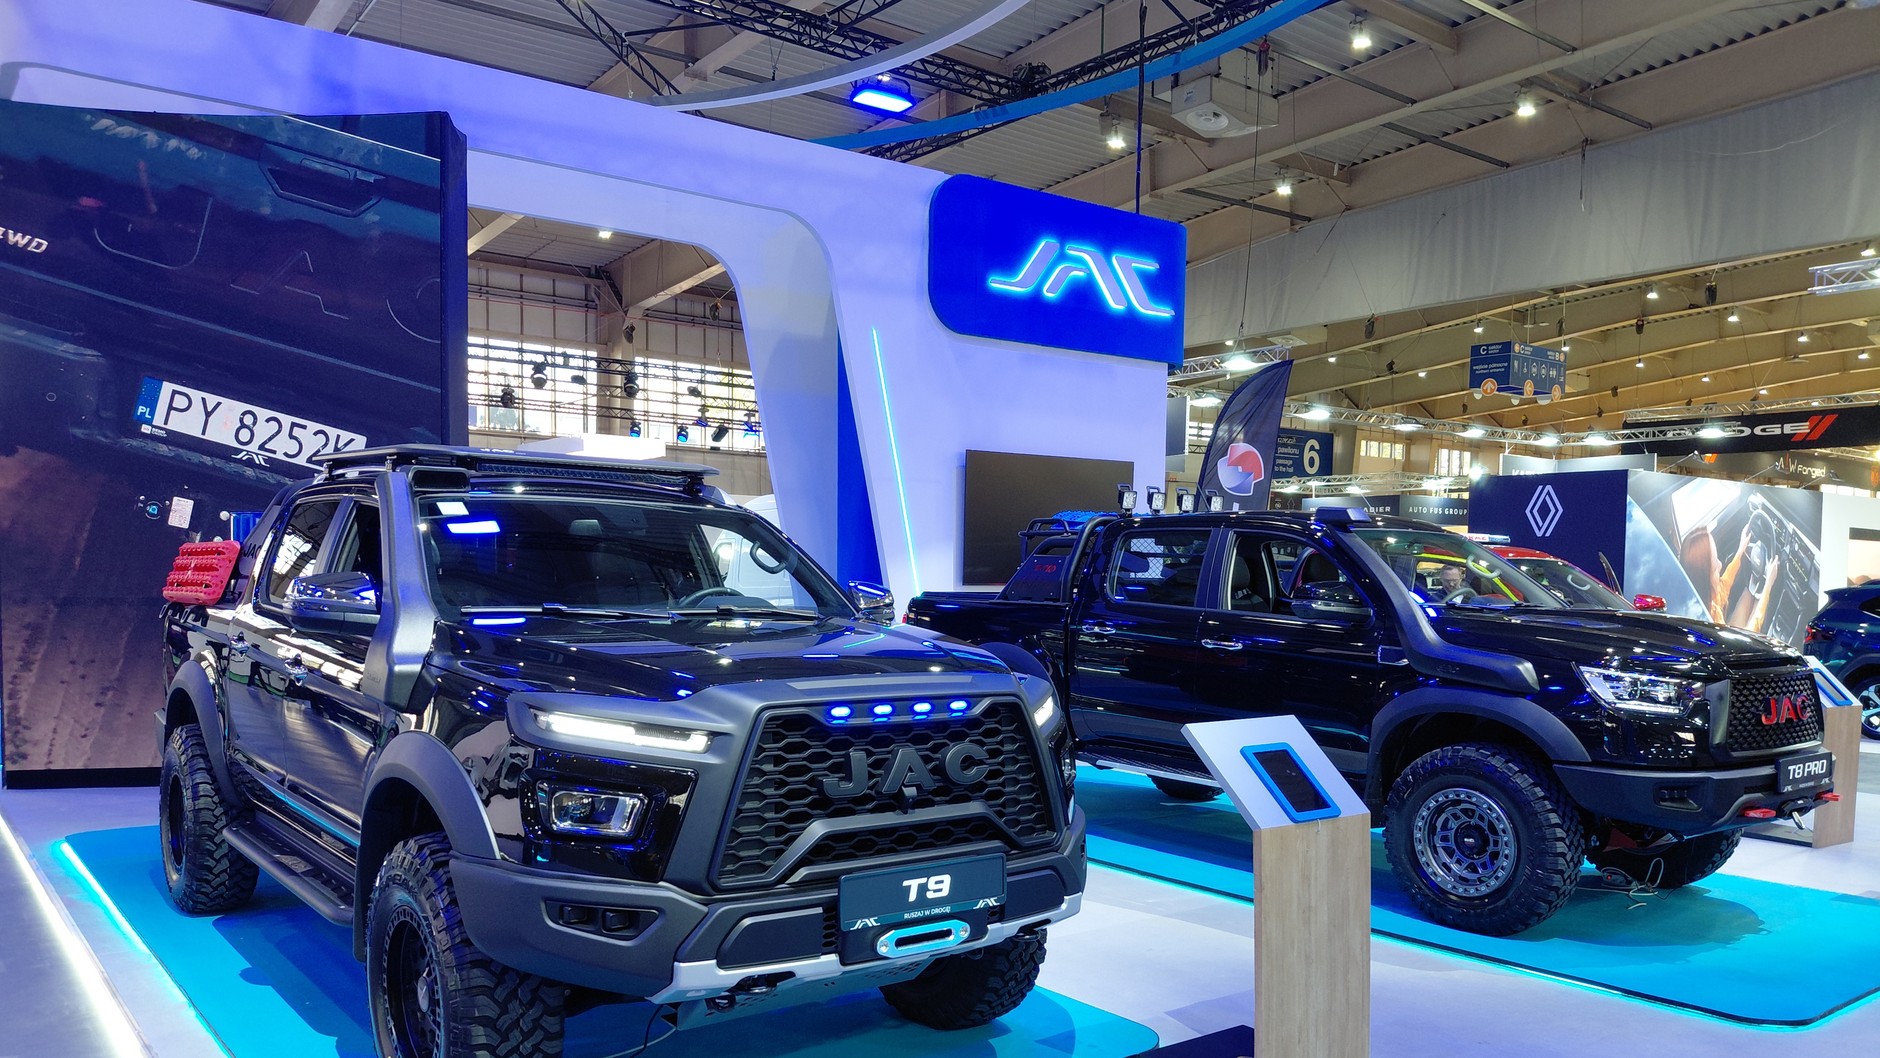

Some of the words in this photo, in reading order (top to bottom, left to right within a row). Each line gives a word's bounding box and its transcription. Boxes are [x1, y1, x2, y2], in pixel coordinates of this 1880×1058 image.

[989, 240, 1176, 316] JAC
[1480, 346, 1487, 354] C
[137, 405, 152, 419] PL
[164, 388, 222, 436] PY
[231, 450, 270, 467] JAC
[1303, 438, 1320, 475] 6
[1797, 464, 1826, 479] Forged
[1409, 506, 1428, 514] AUTO
[1429, 507, 1443, 515] FUS
[1444, 508, 1468, 516] GROUP
[1761, 694, 1811, 725] JAC
[822, 742, 990, 798] JAC
[1788, 764, 1803, 780] T8
[1804, 759, 1827, 776] PRO
[902, 874, 952, 902] T9
[904, 909, 924, 919] RUSZAJ
[924, 908, 931, 916] W
